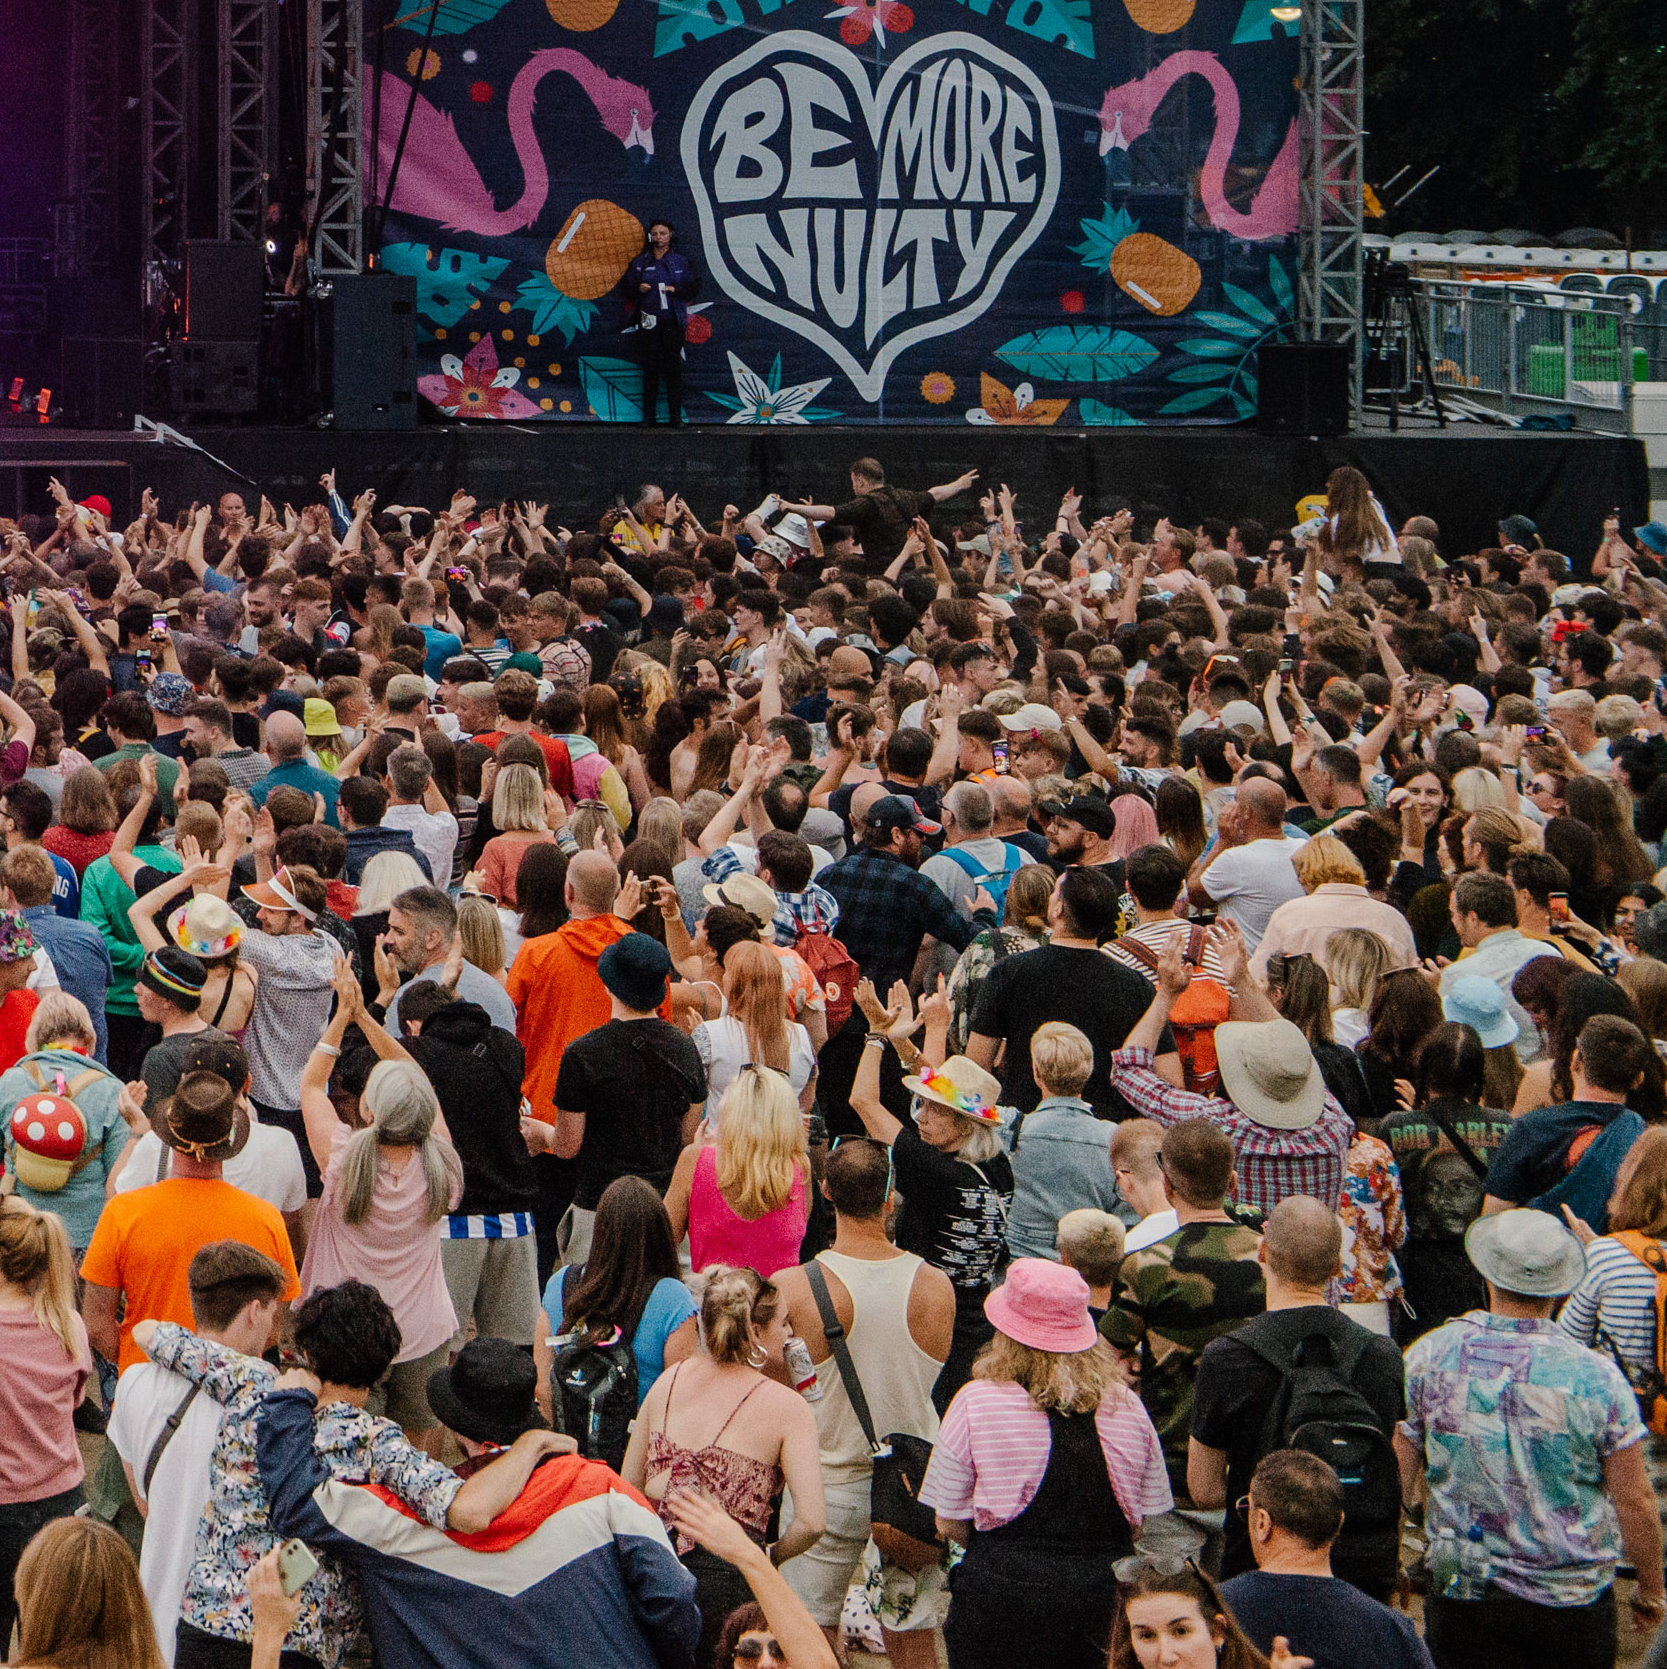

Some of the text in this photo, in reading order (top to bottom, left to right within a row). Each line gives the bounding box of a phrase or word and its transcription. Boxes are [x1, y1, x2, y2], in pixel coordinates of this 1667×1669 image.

[710, 58, 1036, 203] BE MORE
[724, 208, 1017, 350] NULTY
[1390, 1123, 1430, 1150] BOB
